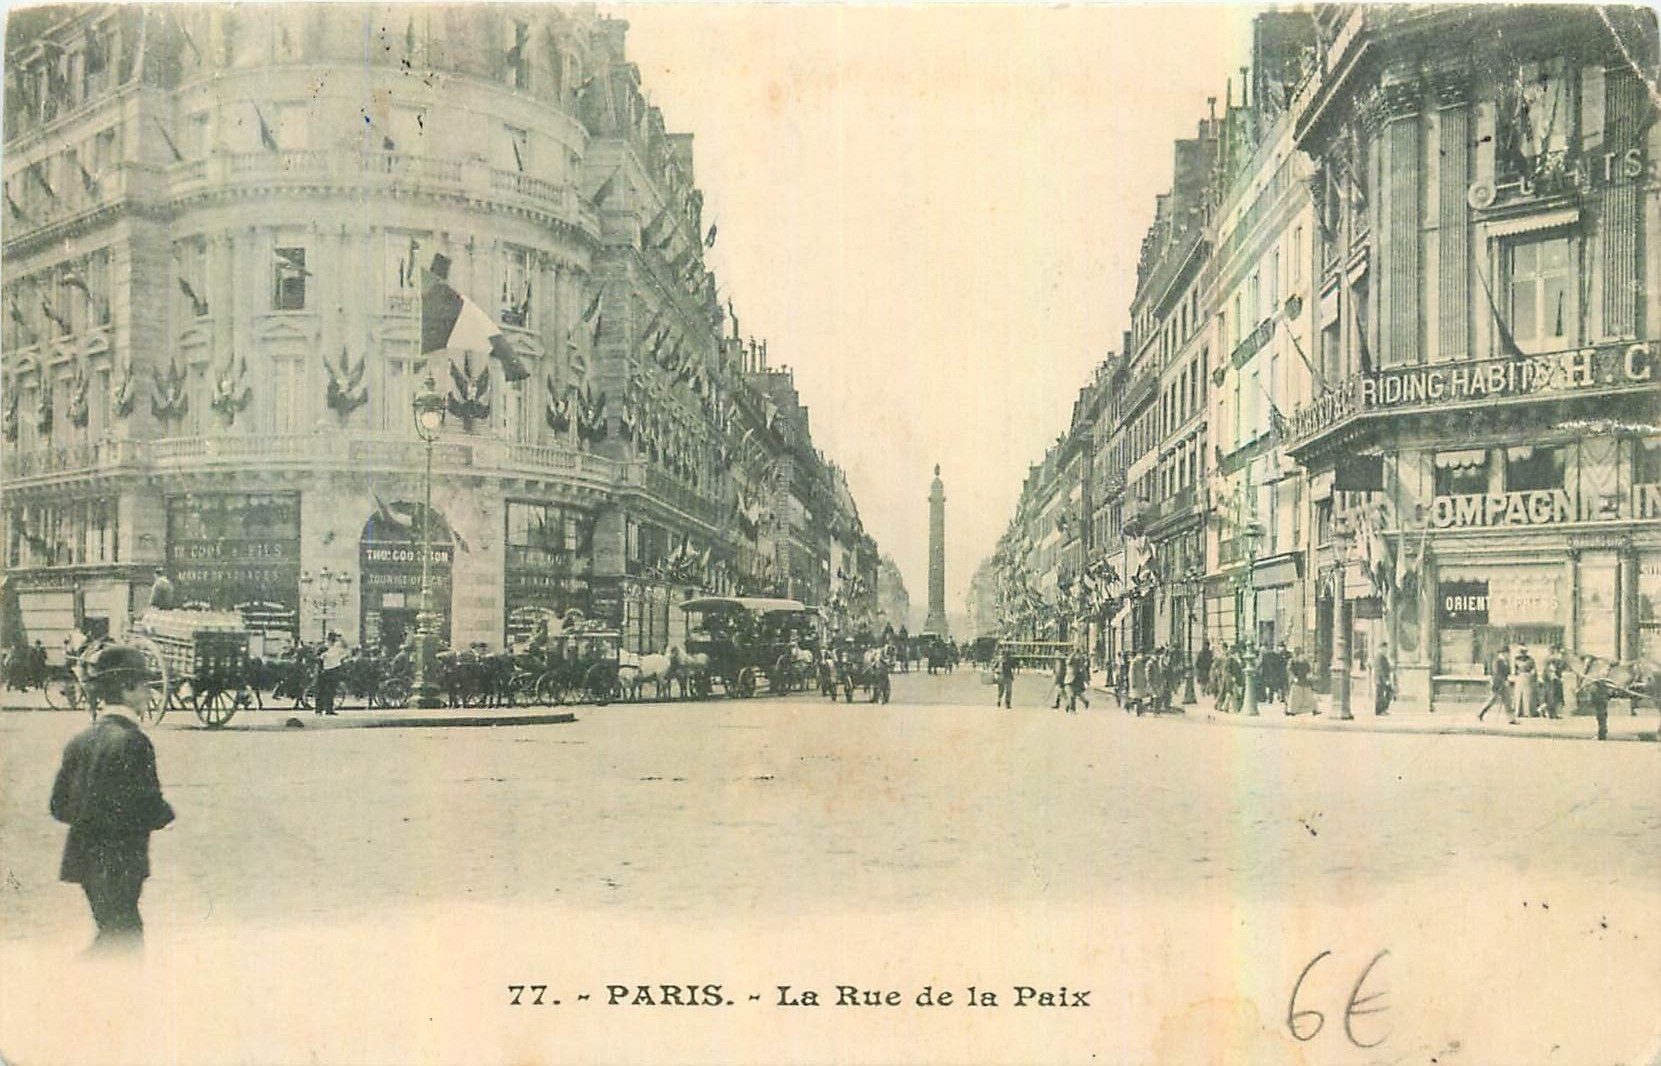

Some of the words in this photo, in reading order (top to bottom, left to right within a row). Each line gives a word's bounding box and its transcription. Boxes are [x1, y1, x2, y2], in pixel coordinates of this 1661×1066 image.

[1361, 372, 1444, 406] RIDING
[1445, 595, 1491, 612] ORIENT
[1286, 949, 1393, 1049] 6€
